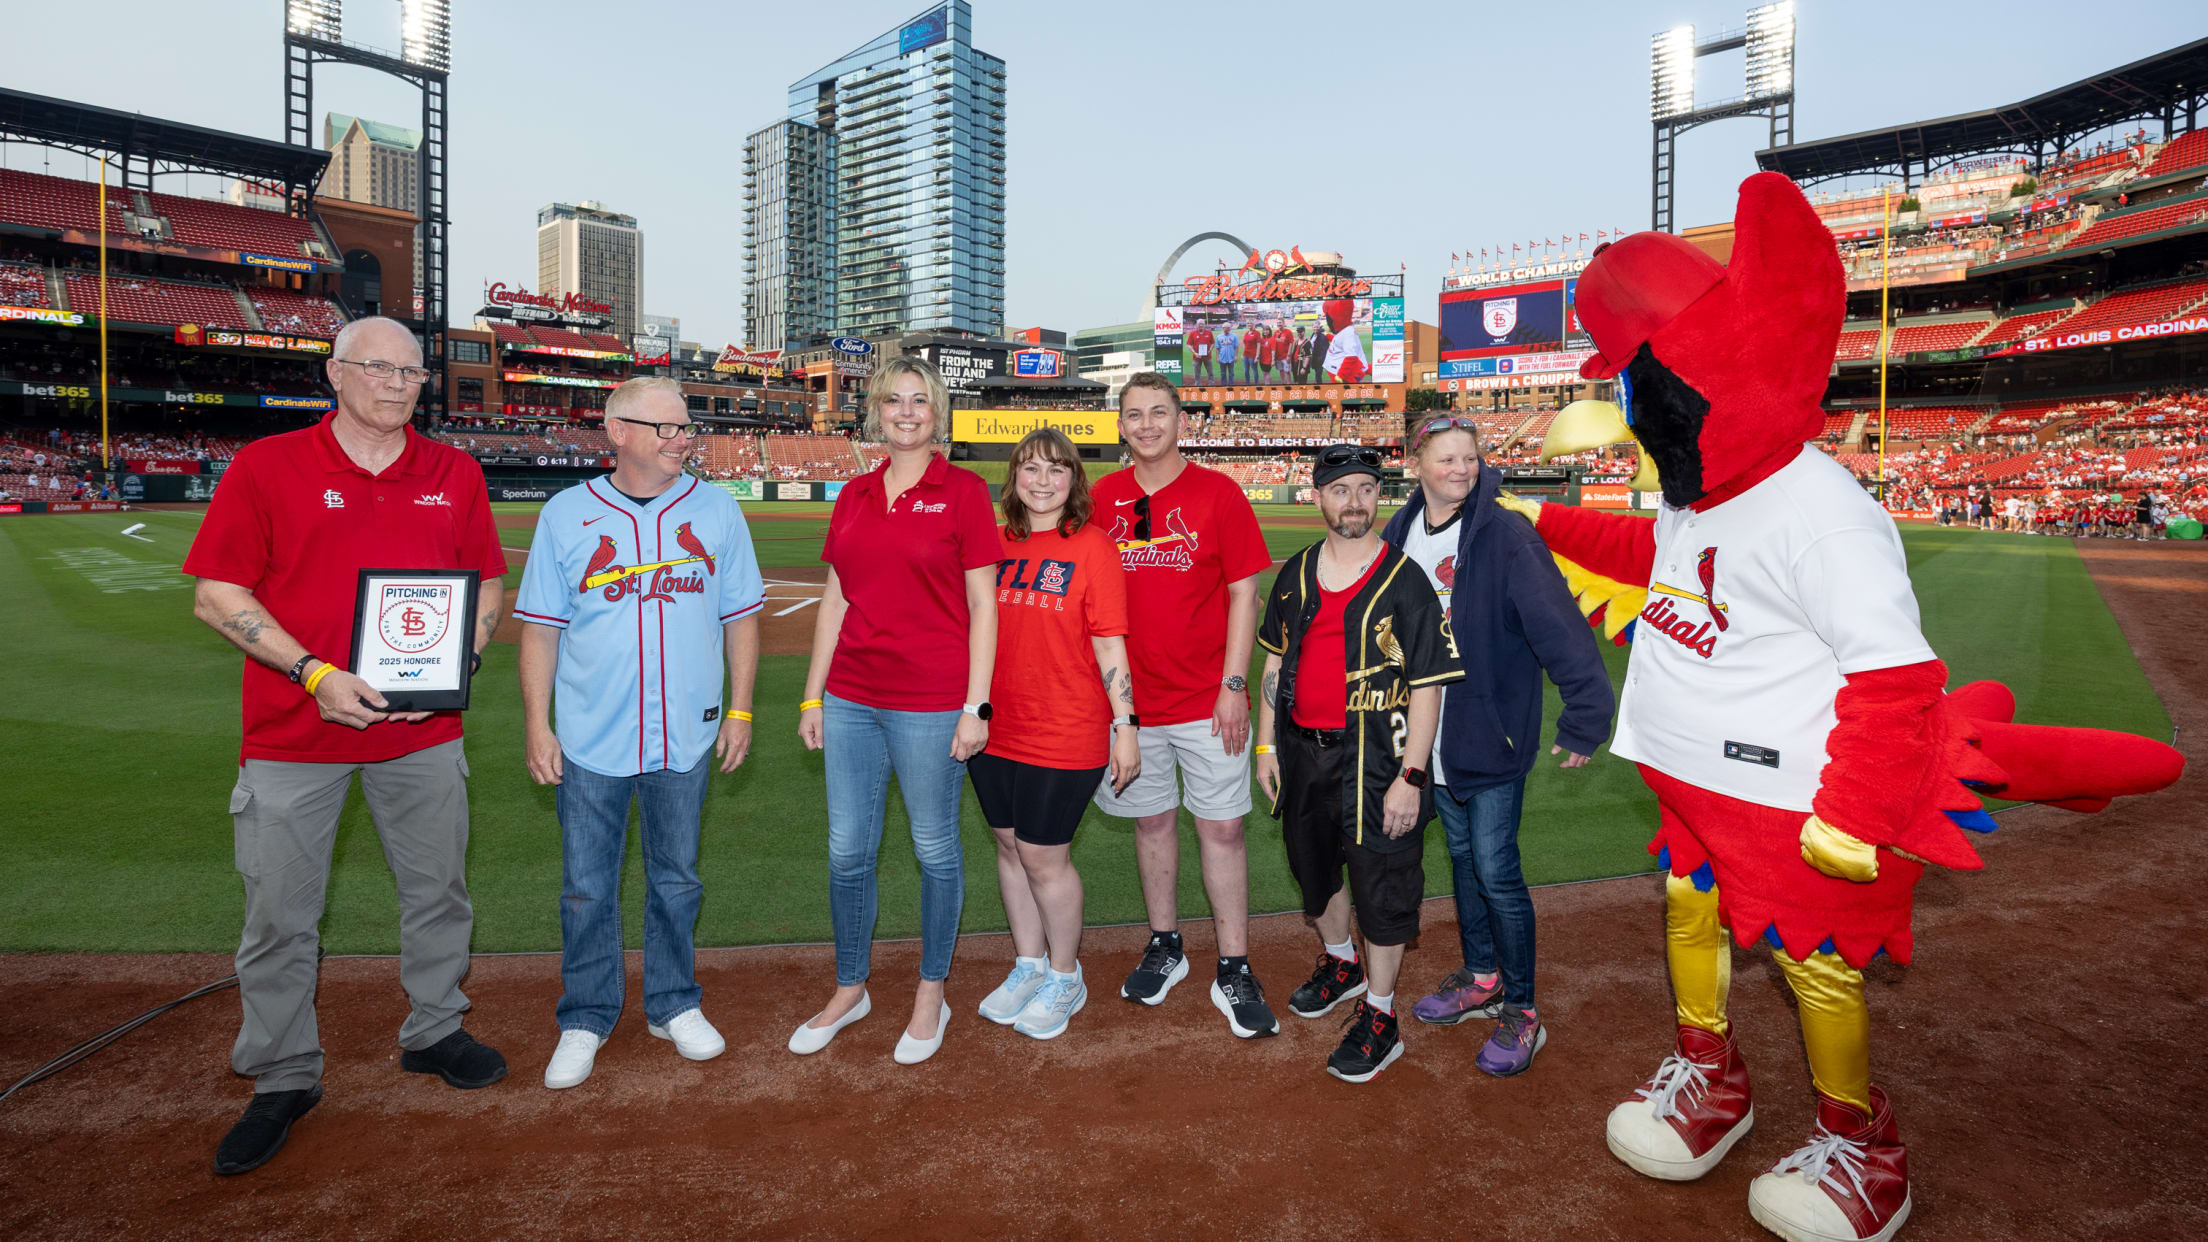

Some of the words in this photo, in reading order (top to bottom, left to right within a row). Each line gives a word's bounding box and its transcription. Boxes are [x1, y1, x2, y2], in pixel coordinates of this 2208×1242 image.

[246, 256, 312, 271] CardinalsWiFi
[1458, 272, 1511, 287] WORLD
[1184, 272, 1372, 305] Budweiser
[489, 282, 557, 307] Cardinals
[556, 292, 612, 315] Nation
[840, 339, 865, 352] Ford
[2025, 339, 2052, 350] ST.
[2057, 330, 2112, 347] LOUIS
[940, 355, 970, 367] FROM
[973, 358, 994, 369] THE
[1452, 361, 1484, 374] STIFEL
[714, 362, 746, 374] BREW
[748, 366, 783, 378] HOUSE
[940, 366, 960, 377] LOU
[963, 368, 986, 378] AND
[546, 376, 599, 387] CARDINALS
[1466, 378, 1509, 390] BROWN
[1512, 378, 1520, 387] &
[1523, 372, 1586, 386] CROUPPE
[23, 383, 90, 398] bet365
[165, 391, 224, 404] bet365
[265, 397, 331, 409] CardinalsWiFi
[976, 418, 1039, 435] Edward
[1043, 419, 1095, 436] Jones
[1177, 438, 1234, 447] WELCOME
[1239, 438, 1255, 446] TO
[1259, 438, 1301, 446] BUSCH
[1306, 438, 1361, 446] STADIUM
[1582, 476, 1597, 484] ST.
[502, 490, 546, 499] Spectrum
[1247, 489, 1273, 500] 365
[642, 565, 705, 604] Louis
[386, 588, 438, 598] PITCHING
[379, 658, 401, 666] 2025
